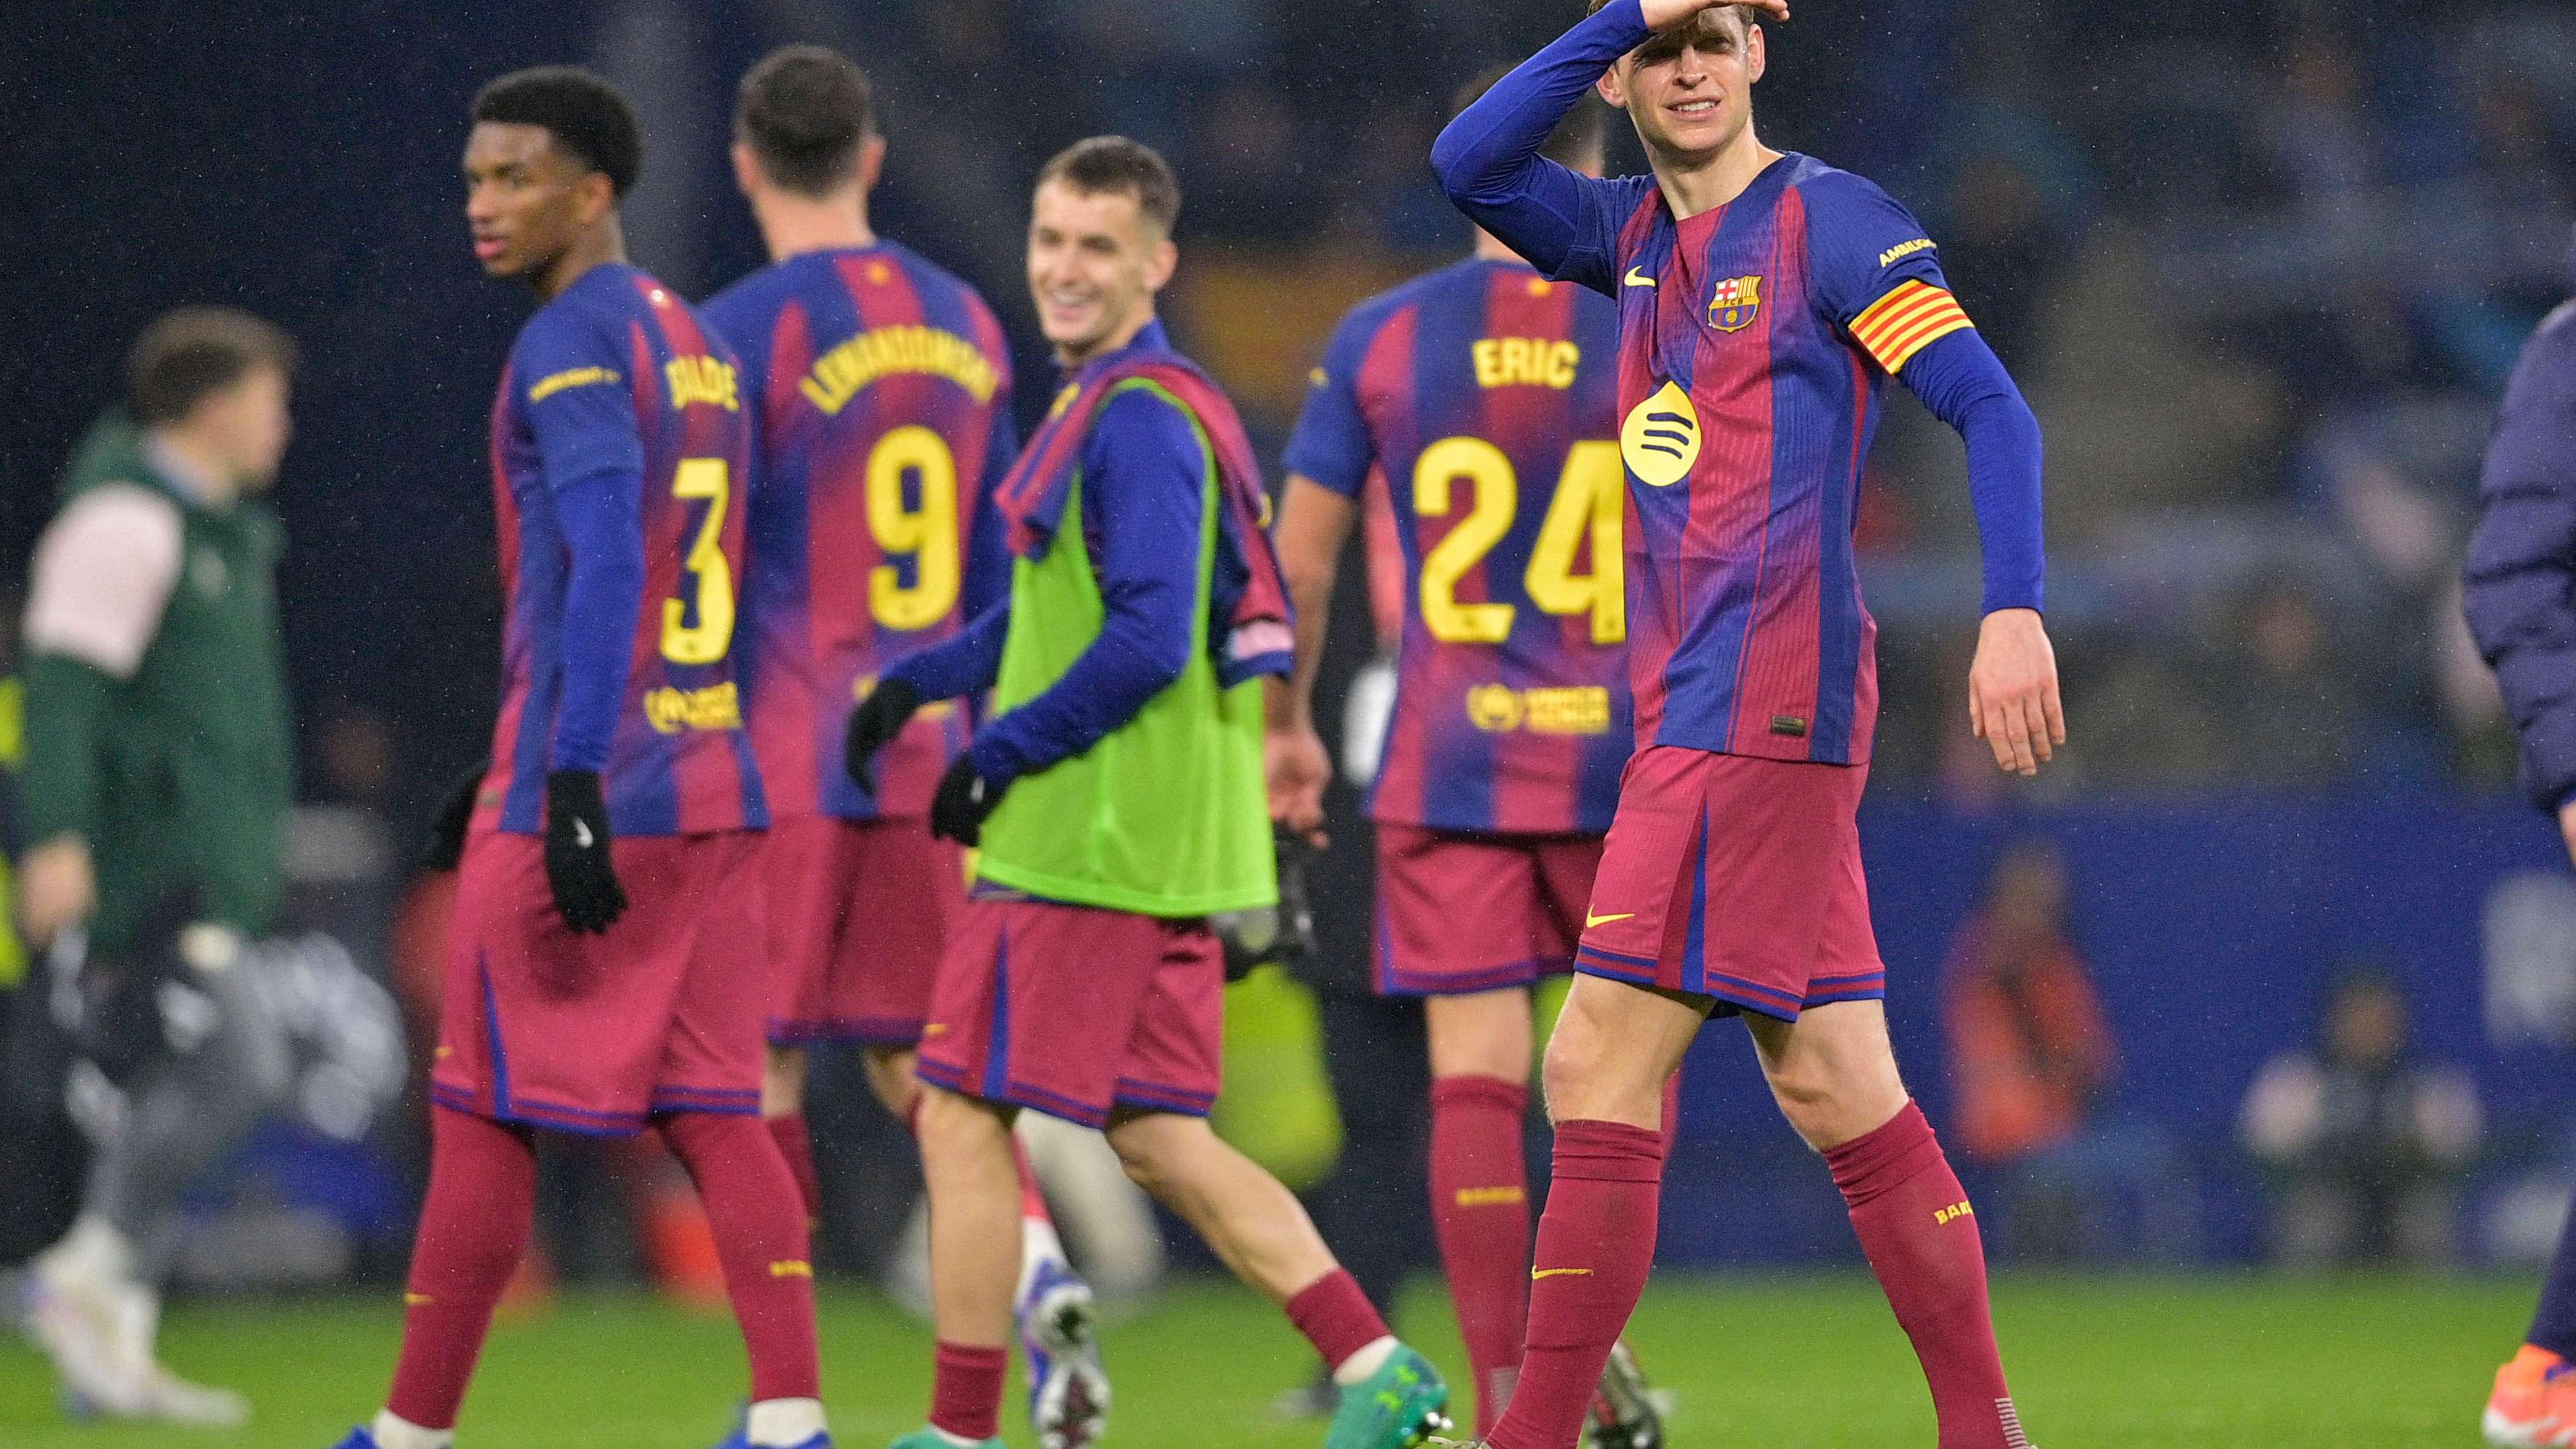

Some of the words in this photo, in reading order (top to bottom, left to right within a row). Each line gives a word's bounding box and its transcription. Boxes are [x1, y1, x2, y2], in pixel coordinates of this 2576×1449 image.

[1472, 337, 1580, 389] ERIC
[661, 458, 735, 665] 3
[865, 424, 960, 631] 9
[1412, 435, 1626, 644] 24
